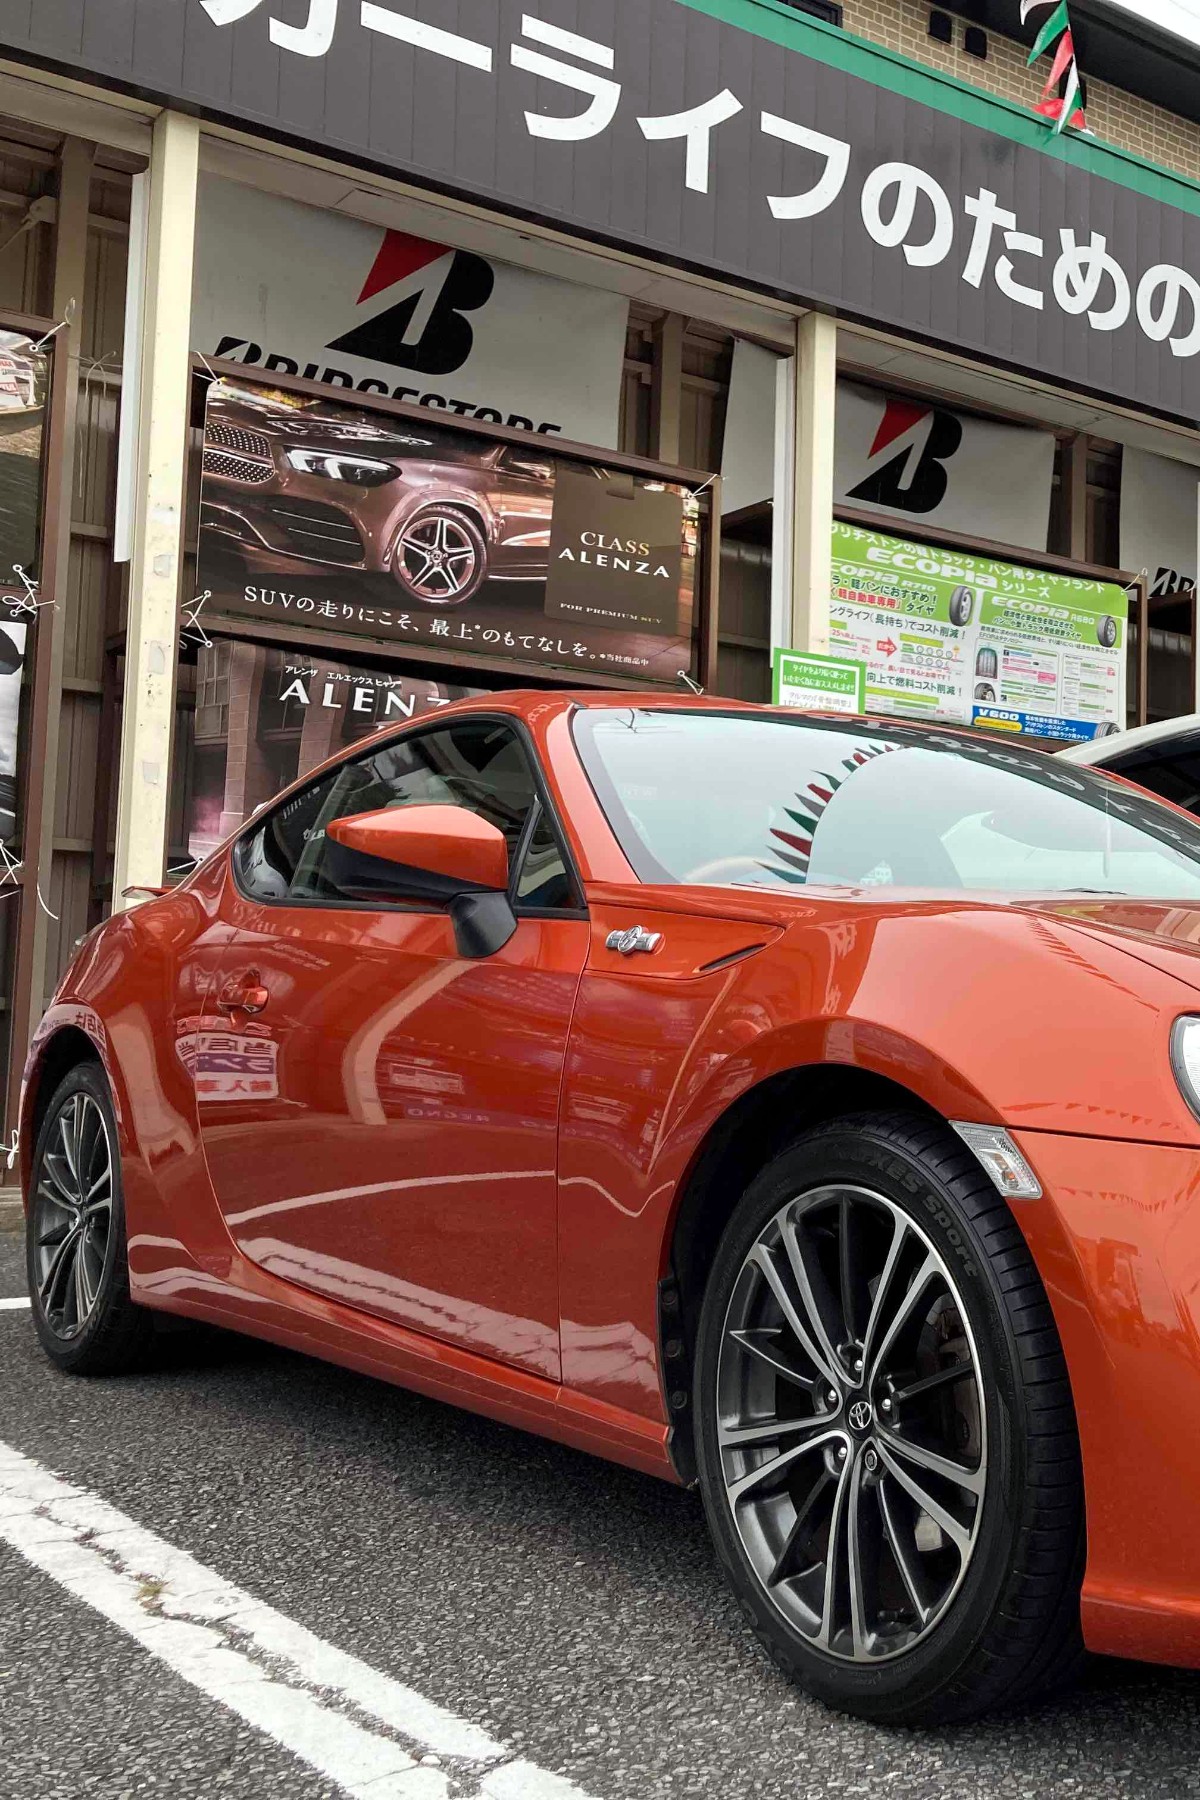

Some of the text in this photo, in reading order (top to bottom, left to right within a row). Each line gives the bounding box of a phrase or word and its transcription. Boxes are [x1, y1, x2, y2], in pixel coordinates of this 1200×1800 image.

[580, 531, 650, 556] CLASS
[558, 547, 670, 578] ALENZA
[1002, 579, 1050, 598] シリーズ
[560, 602, 583, 612] FOR
[586, 606, 638, 620] PREMIUM
[906, 602, 935, 616] タイヤ
[978, 708, 1019, 721] V600
